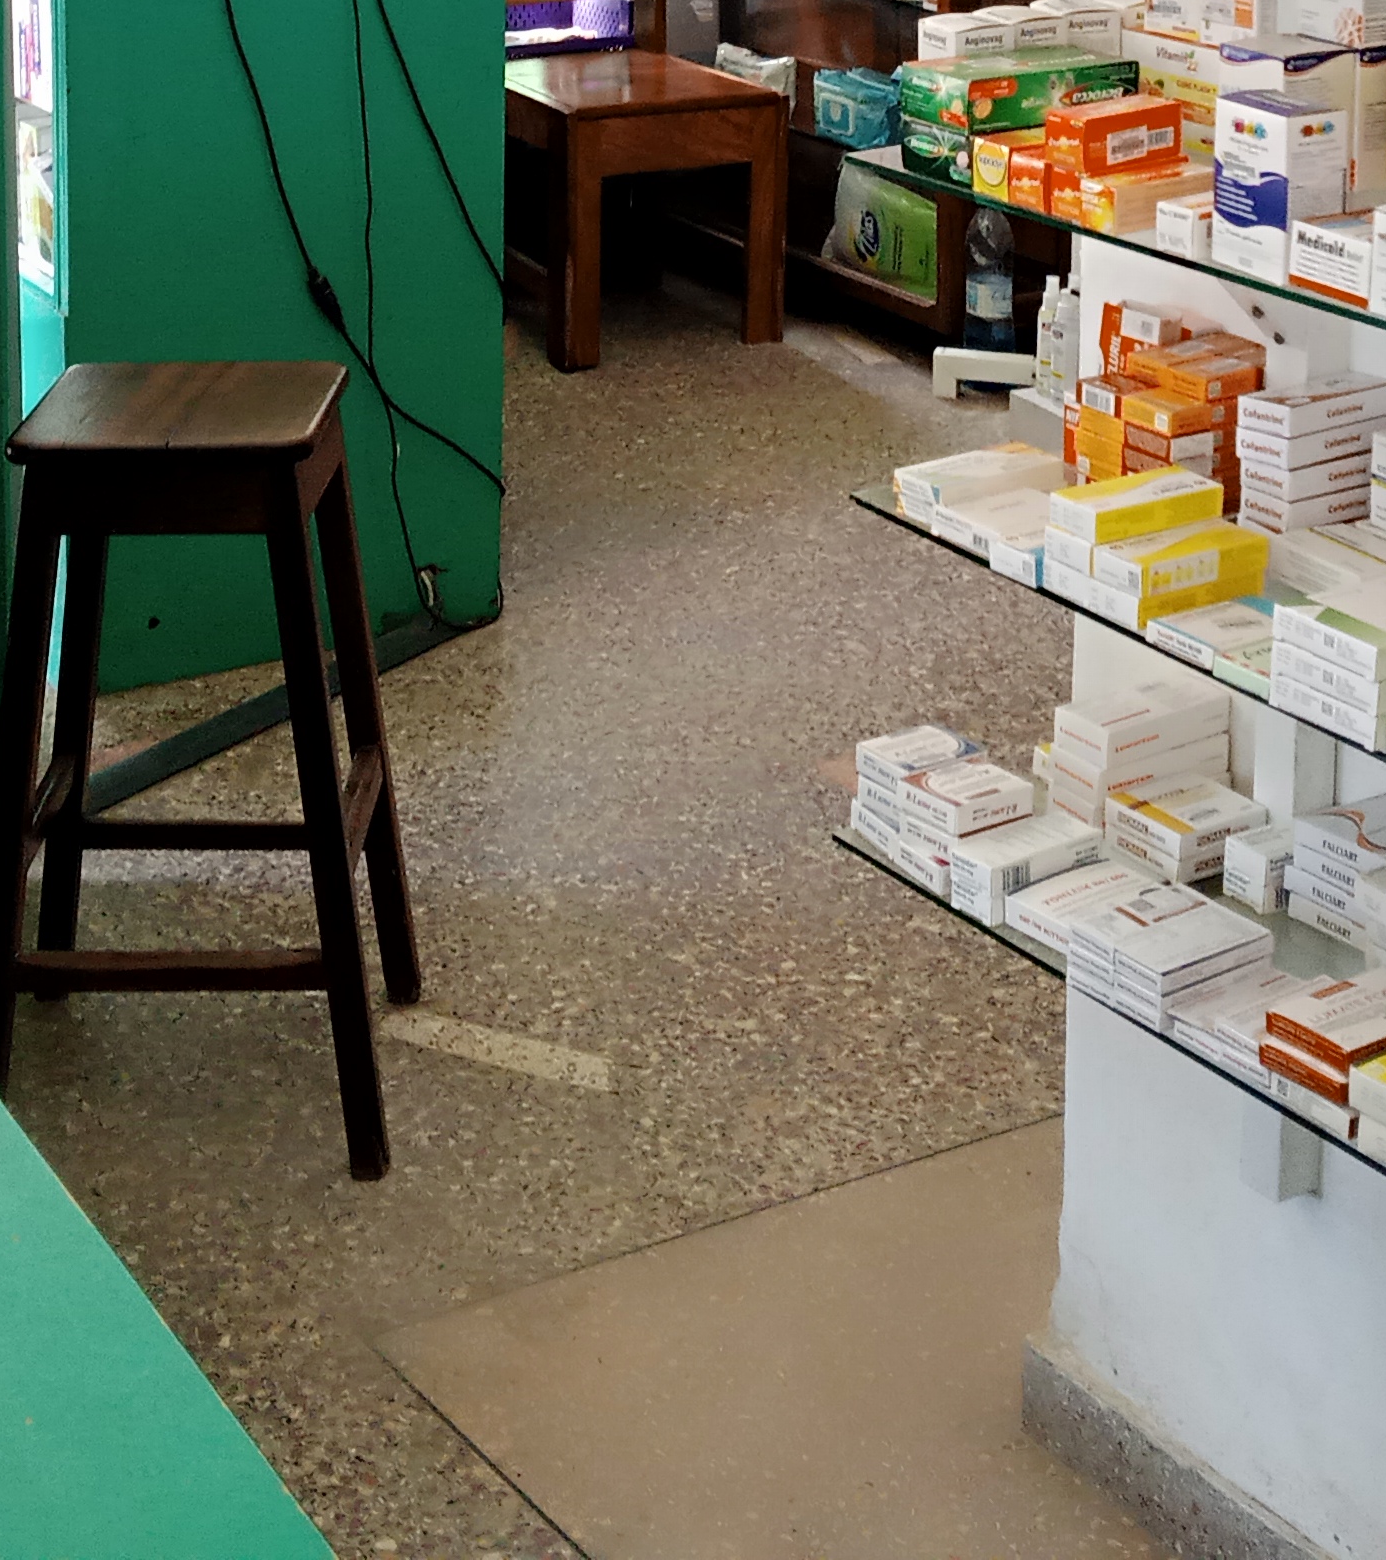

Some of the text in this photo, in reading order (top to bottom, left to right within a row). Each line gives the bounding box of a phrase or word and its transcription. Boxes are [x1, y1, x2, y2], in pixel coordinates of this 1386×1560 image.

[1297, 229, 1345, 258] Medicold
[1322, 839, 1358, 863] FALCIART
[1321, 863, 1355, 888] FALCIART
[1312, 886, 1346, 911] FALCIART
